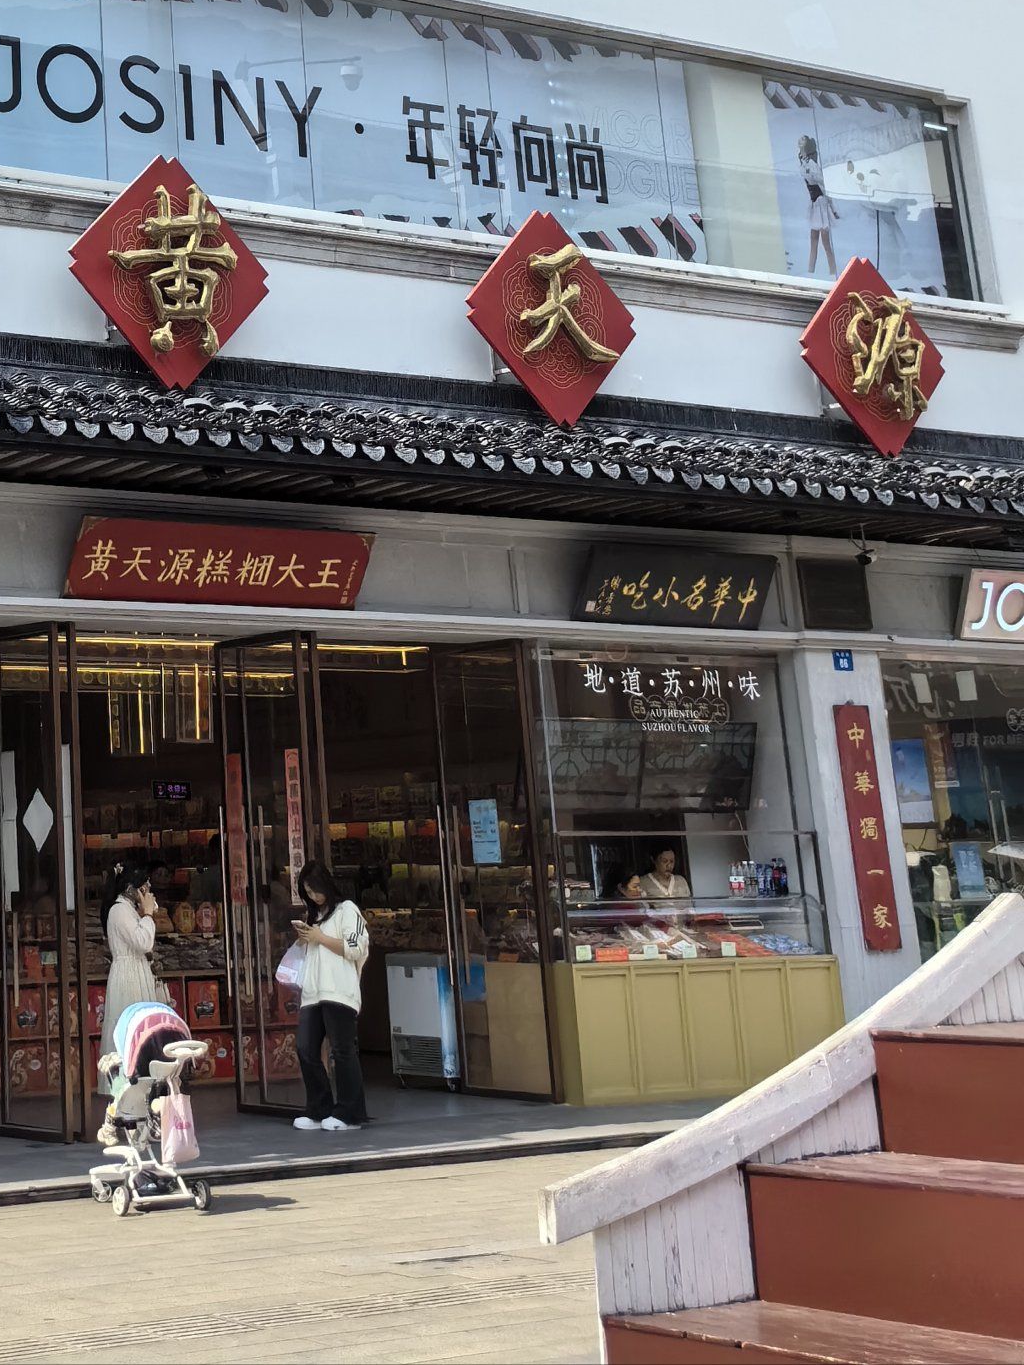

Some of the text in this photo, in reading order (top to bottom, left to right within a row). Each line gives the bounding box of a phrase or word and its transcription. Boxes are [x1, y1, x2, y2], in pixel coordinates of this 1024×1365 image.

[402, 95, 609, 204] 年轻向尚
[649, 708, 700, 719] AUTHENTIC
